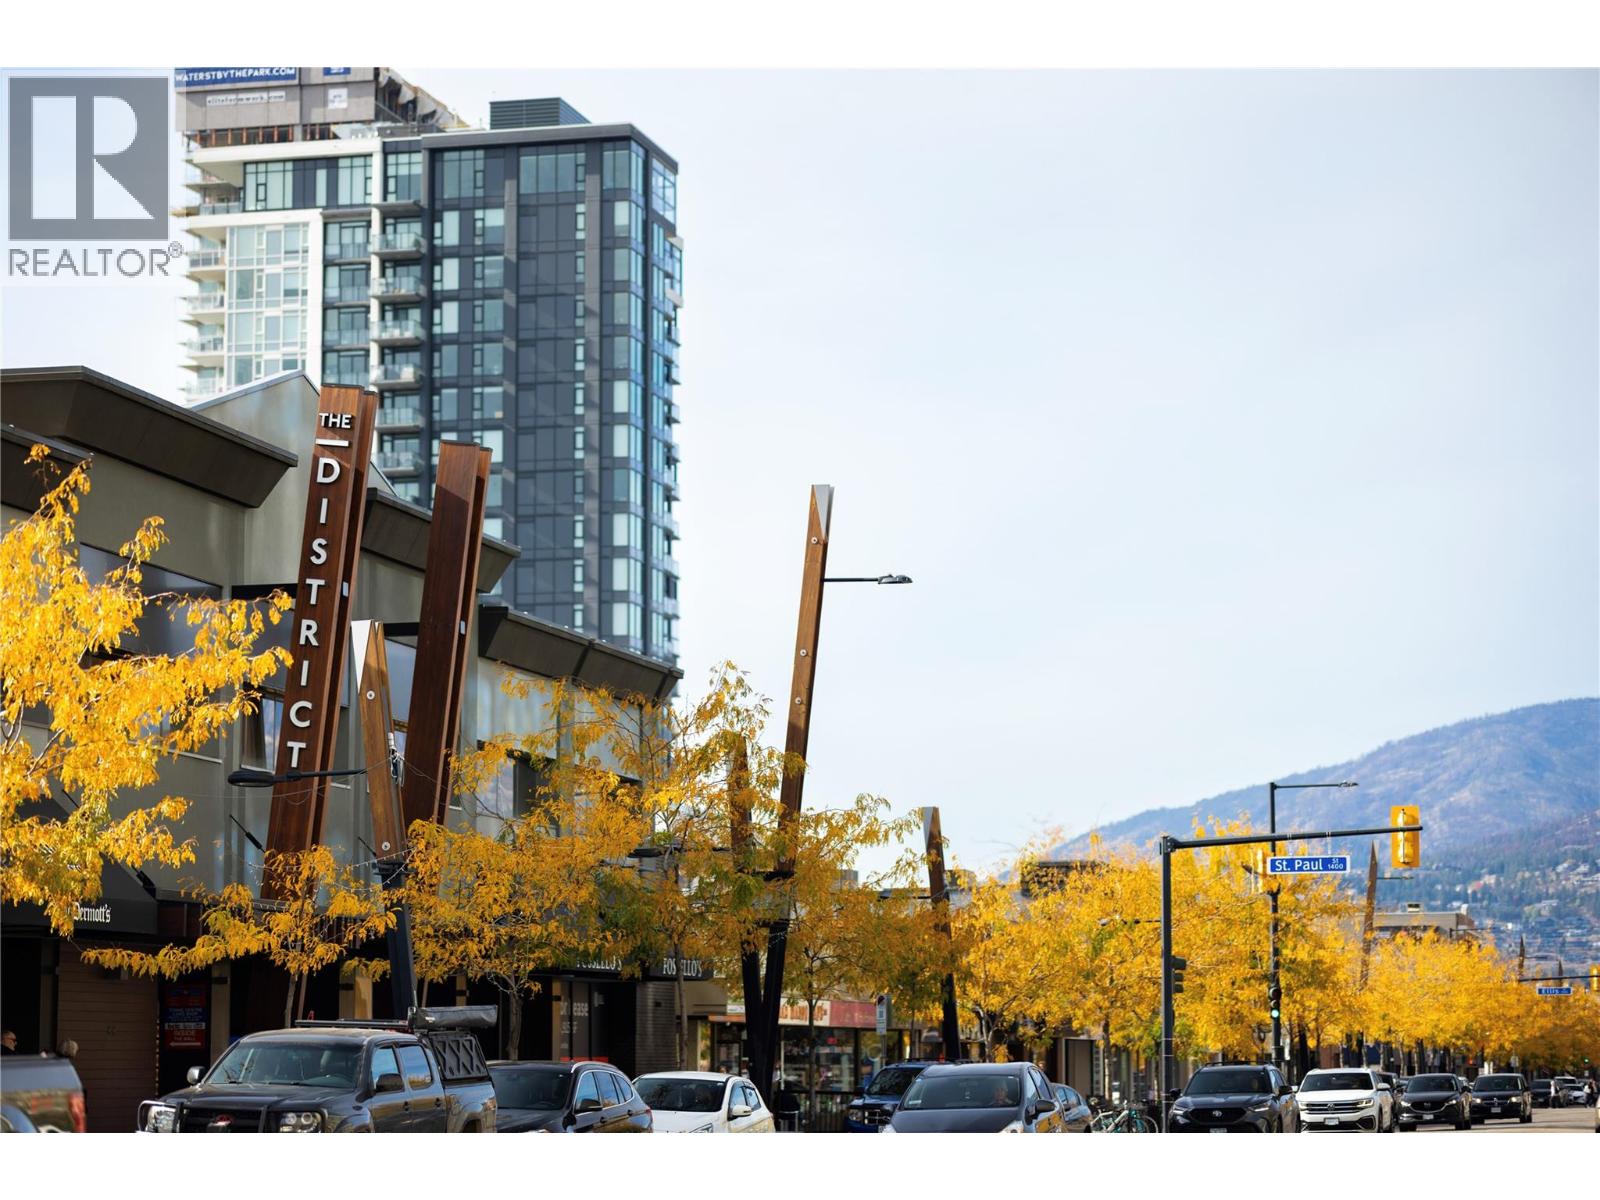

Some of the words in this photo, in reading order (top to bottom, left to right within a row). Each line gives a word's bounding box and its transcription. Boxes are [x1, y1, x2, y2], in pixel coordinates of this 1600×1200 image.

[319, 412, 352, 429] THE
[286, 456, 341, 768] DISTRICT
[1275, 860, 1291, 871] St.
[1294, 858, 1323, 871] Paul
[663, 958, 702, 977] FOSLLO'S
